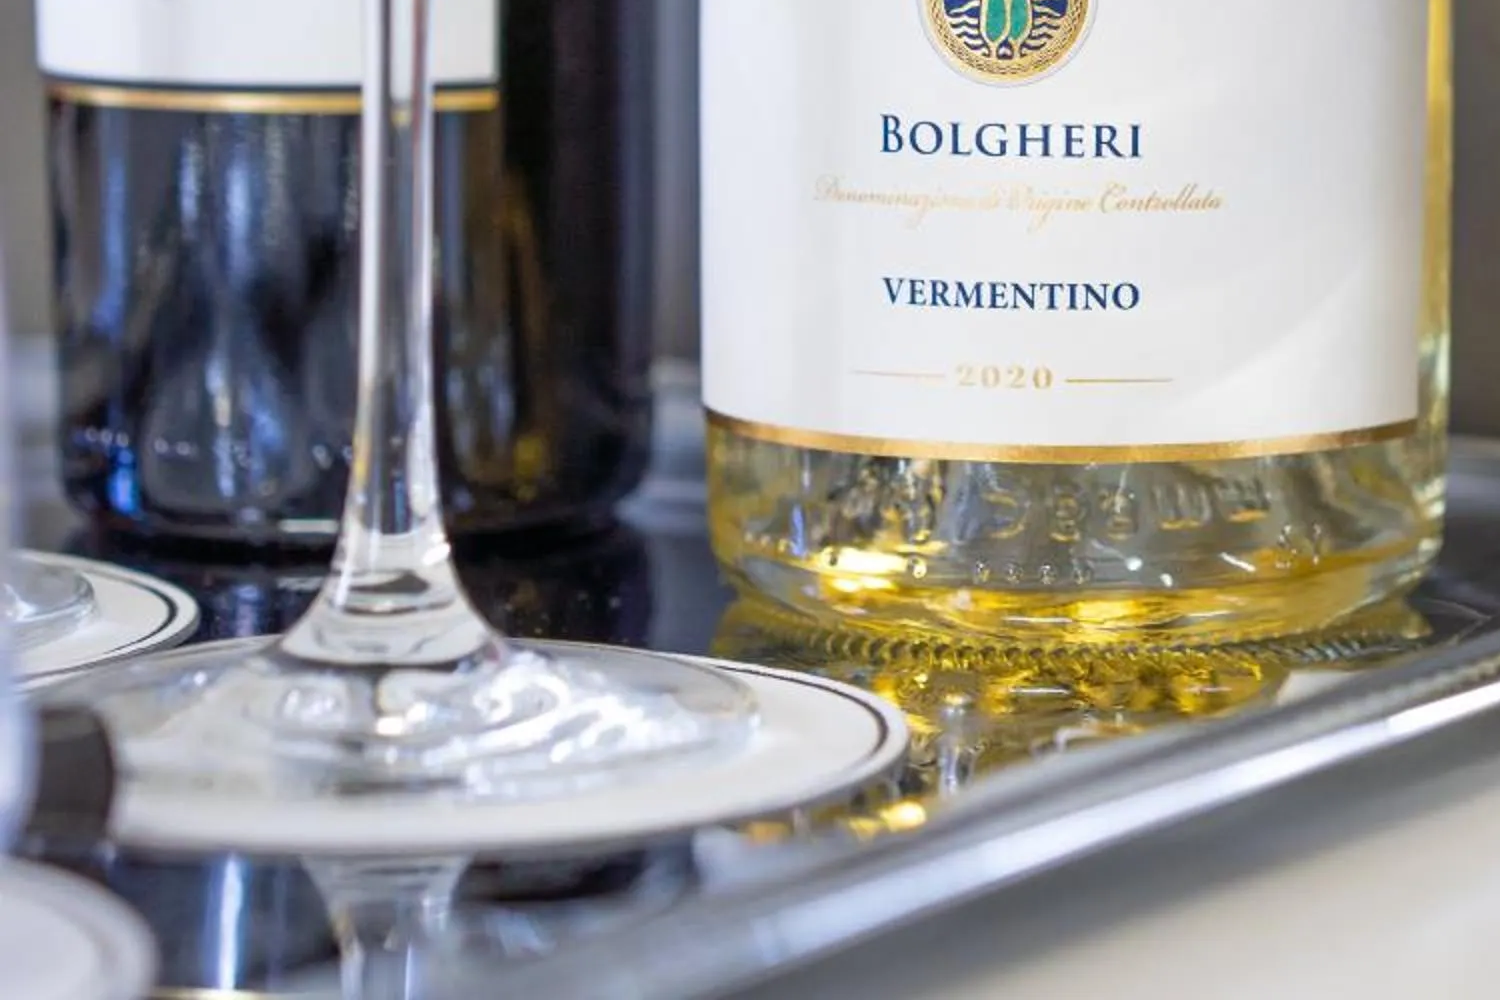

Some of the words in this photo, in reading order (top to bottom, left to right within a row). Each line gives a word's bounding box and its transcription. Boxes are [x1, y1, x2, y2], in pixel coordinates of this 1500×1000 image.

[880, 113, 1143, 159] BOLGHERI
[1098, 180, 1225, 214] Controllata
[882, 277, 1141, 311] VERMENTINO
[957, 364, 1054, 391] 2020
